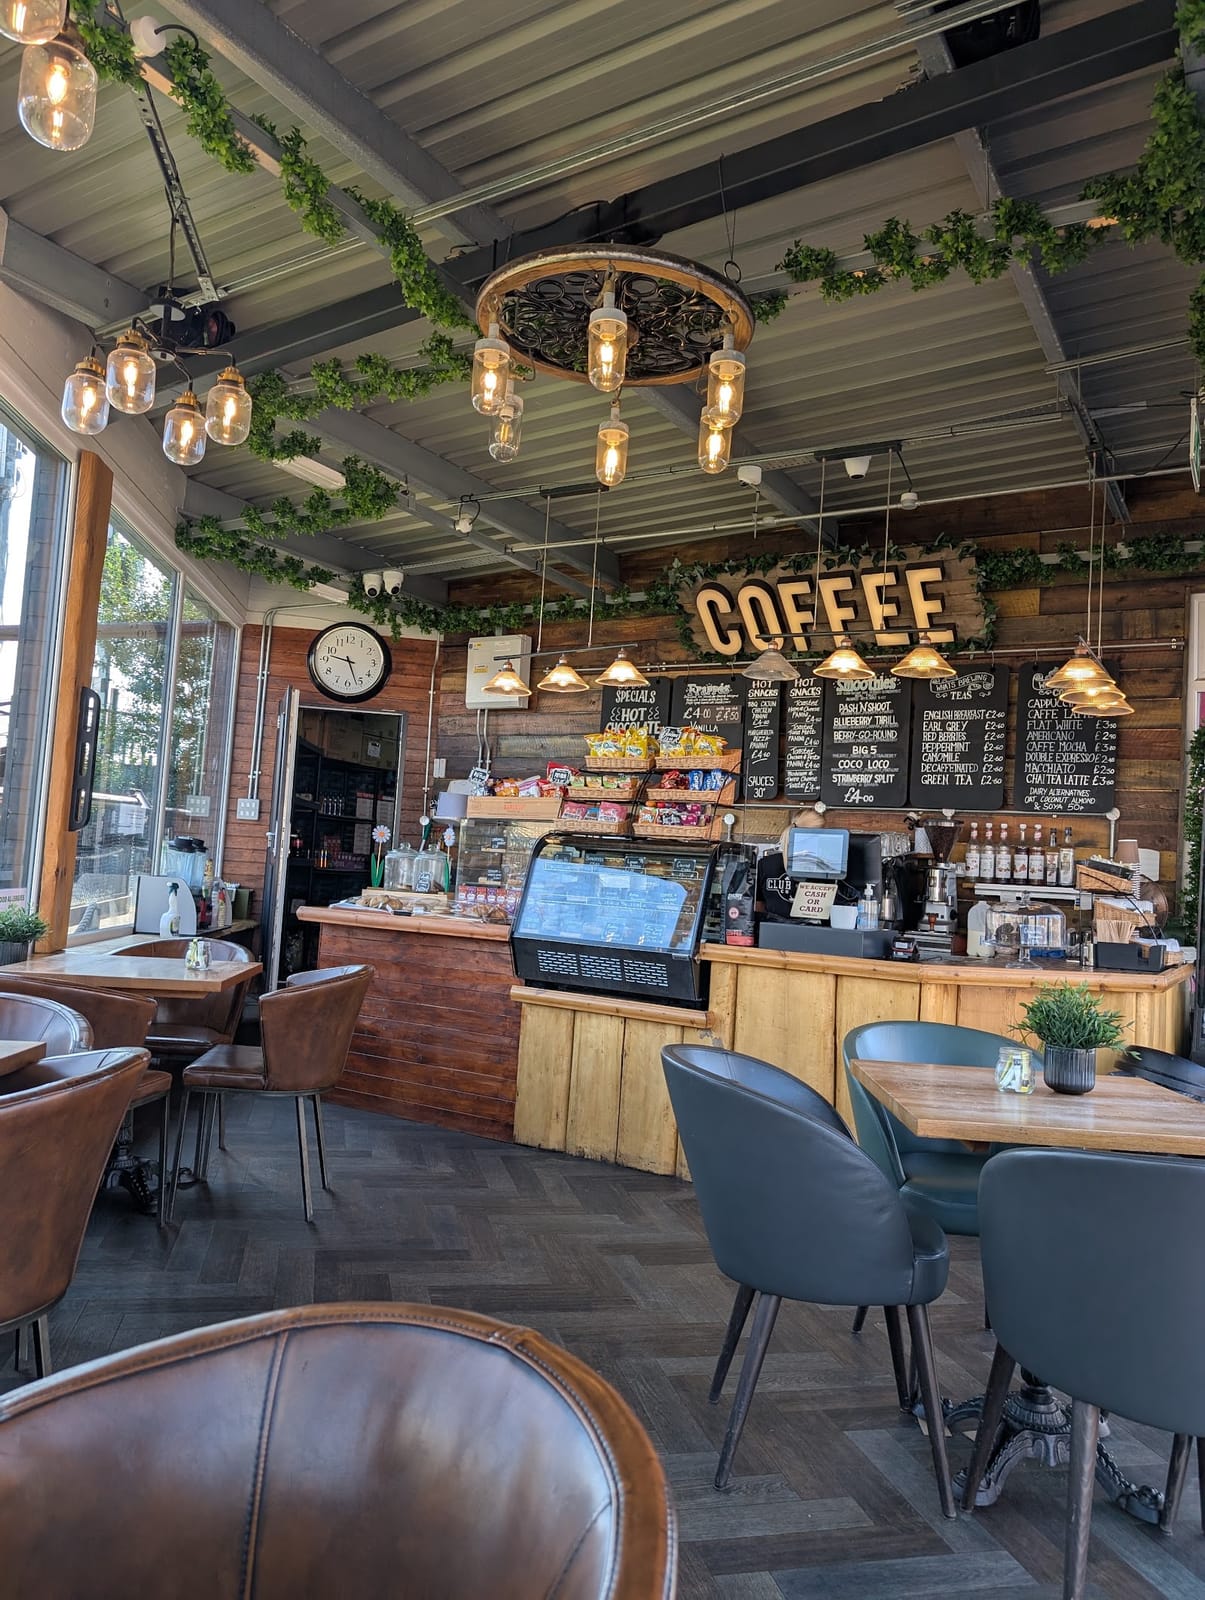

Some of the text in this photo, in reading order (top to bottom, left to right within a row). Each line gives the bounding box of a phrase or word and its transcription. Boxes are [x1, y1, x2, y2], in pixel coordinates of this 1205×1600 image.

[695, 563, 957, 656] COFFEE
[336, 639, 344, 647] 11
[346, 635, 356, 645] 12
[327, 646, 337, 655] 10
[366, 647, 372, 656] 2
[322, 655, 329, 663] 9
[371, 659, 376, 667] 3
[325, 667, 332, 675] 8
[365, 670, 371, 678] 4
[334, 675, 341, 683] 7
[344, 680, 351, 688] 6
[358, 677, 363, 685] 5
[794, 677, 817, 687] HOT
[958, 674, 987, 687] BREWING
[752, 680, 772, 689] HOT
[615, 689, 657, 704] SPECIALS
[748, 688, 779, 697] SNACKS
[789, 686, 822, 697] SNACKS
[950, 691, 972, 700] TEAS
[838, 703, 859, 713] PASH
[868, 701, 892, 712] SHOOT
[1027, 698, 1073, 709] CAPPUCC
[621, 707, 648, 721] HOT
[923, 710, 953, 720] ENGLISH
[953, 709, 986, 720] BREAKFAST
[1028, 709, 1059, 719] CAFFE
[833, 716, 873, 726] BLUEBERRY
[874, 715, 897, 725] THRILL
[1026, 720, 1052, 730] FLAT
[1055, 720, 1083, 730] WHITE
[923, 721, 943, 731] EARL
[945, 721, 968, 731] GREY
[833, 730, 898, 740] BERRY-GO-ROUND
[922, 732, 937, 741] RED
[938, 732, 967, 742] BERRIES
[1026, 731, 1075, 741] AMERICANO
[852, 745, 878, 755] BIG 5
[921, 741, 971, 752] PEPPERMINT
[1026, 742, 1056, 751] CAFFE
[1059, 742, 1087, 752] MOCHA
[922, 752, 960, 762] CAMOMILE
[1025, 752, 1054, 762] DOUBLE
[1055, 752, 1095, 763] EXPRESSO
[838, 759, 890, 769] COCO LOCO
[921, 762, 979, 773] DECAFFEINATED
[1024, 762, 1076, 774] MACCHIATO
[748, 775, 775, 787] SAUCES
[874, 774, 895, 784] SPLIT
[921, 773, 949, 785] GREEN
[954, 774, 973, 785] TEA
[1026, 774, 1045, 785] CHAI
[1046, 774, 1062, 785] TEA
[1063, 774, 1090, 786] LATTE
[1029, 787, 1091, 797] DAIRY ALTERNATIVES
[1024, 796, 1037, 804] OAT
[1033, 802, 1041, 811] &
[767, 879, 792, 890] CLUB
[804, 890, 827, 898] CASH
[799, 905, 824, 913] CARD
